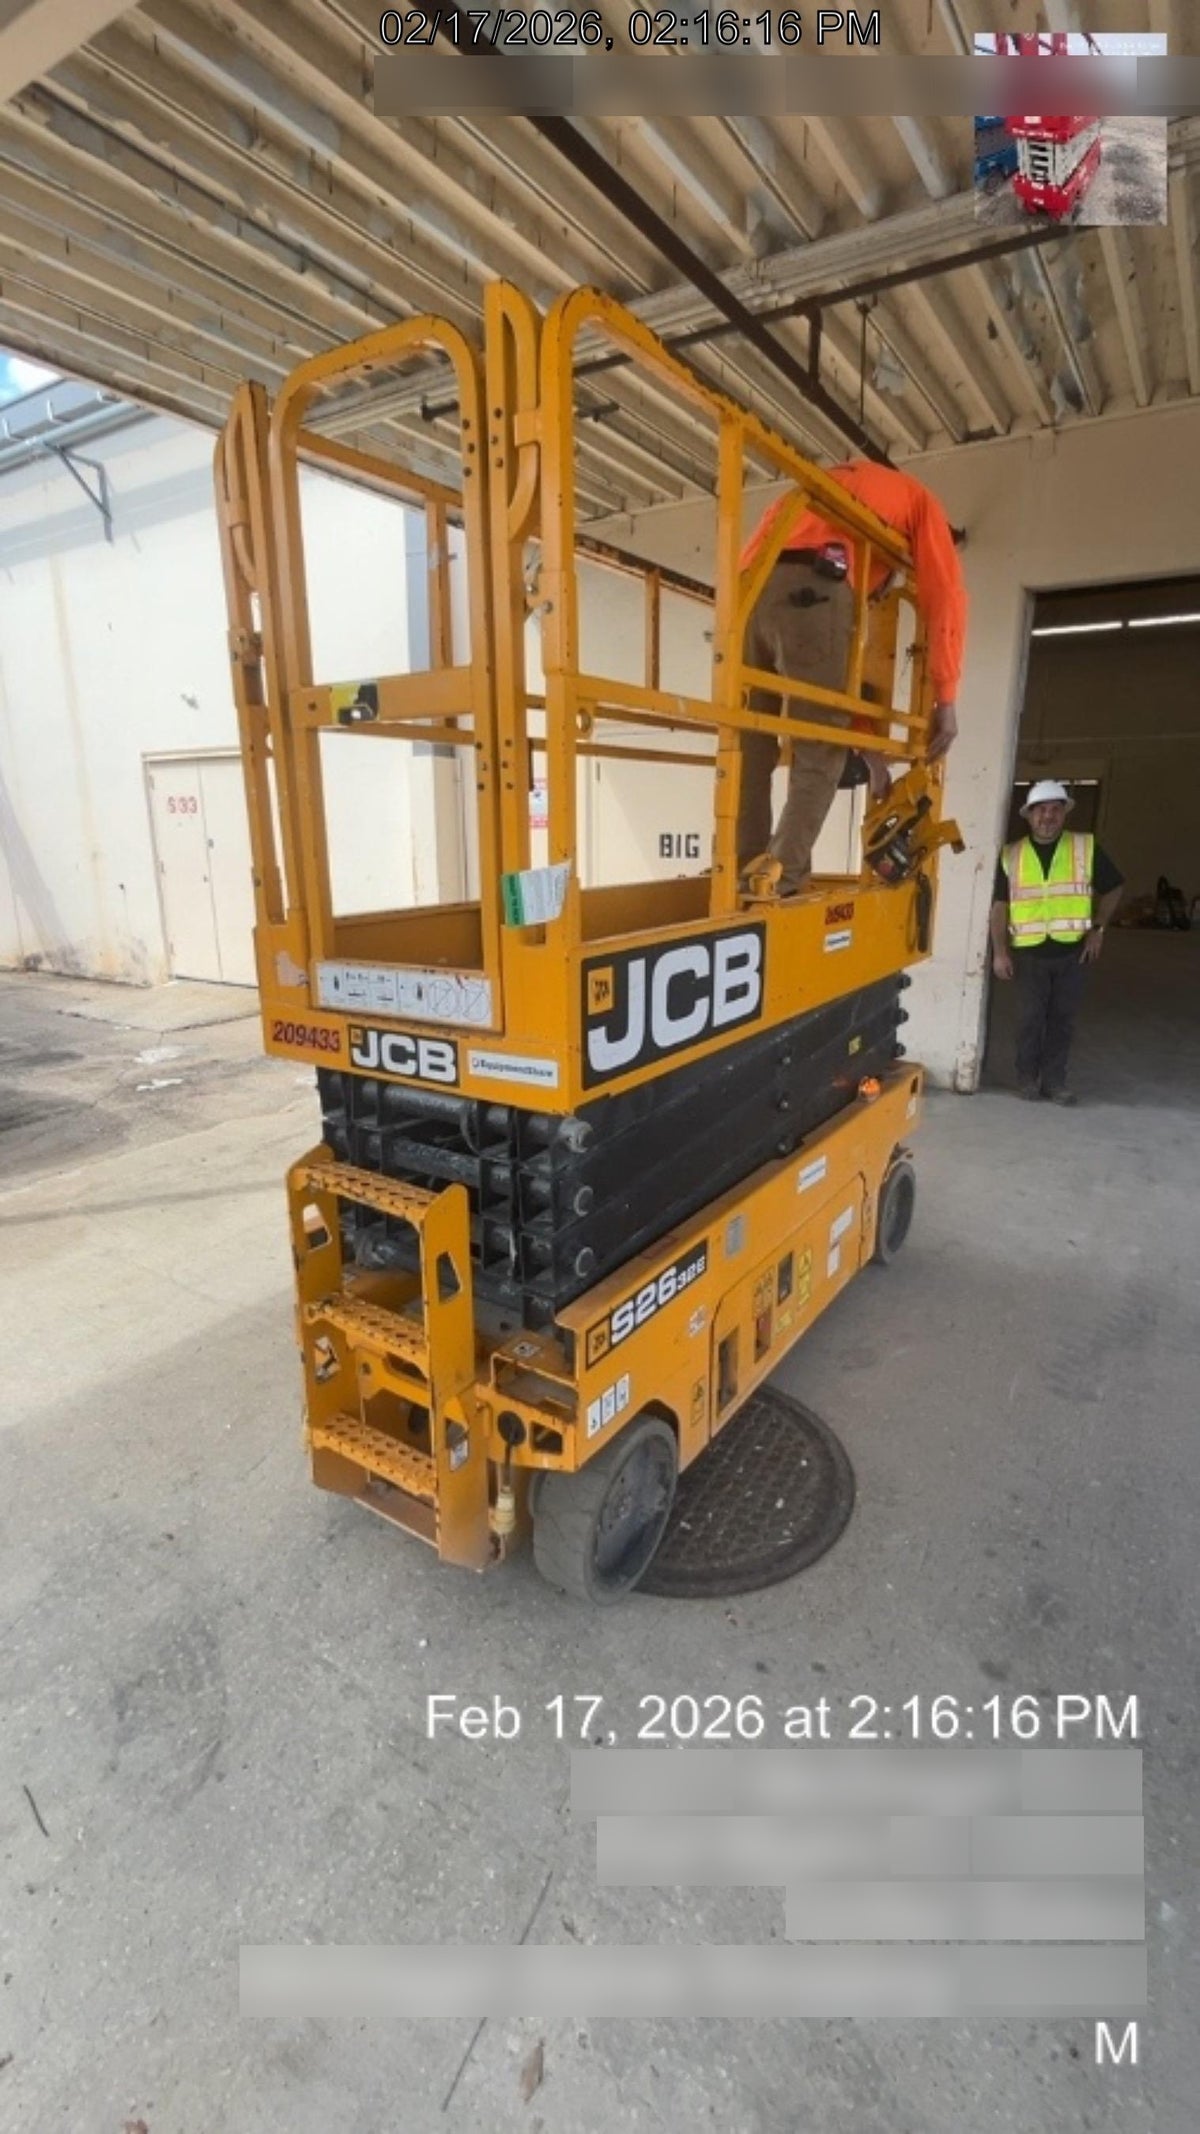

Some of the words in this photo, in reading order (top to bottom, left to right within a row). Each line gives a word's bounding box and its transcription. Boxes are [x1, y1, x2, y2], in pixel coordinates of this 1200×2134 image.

[659, 833, 700, 859] BIG
[587, 932, 762, 1073] JCB
[272, 1020, 341, 1053] 209433
[352, 1030, 457, 1083] JCB
